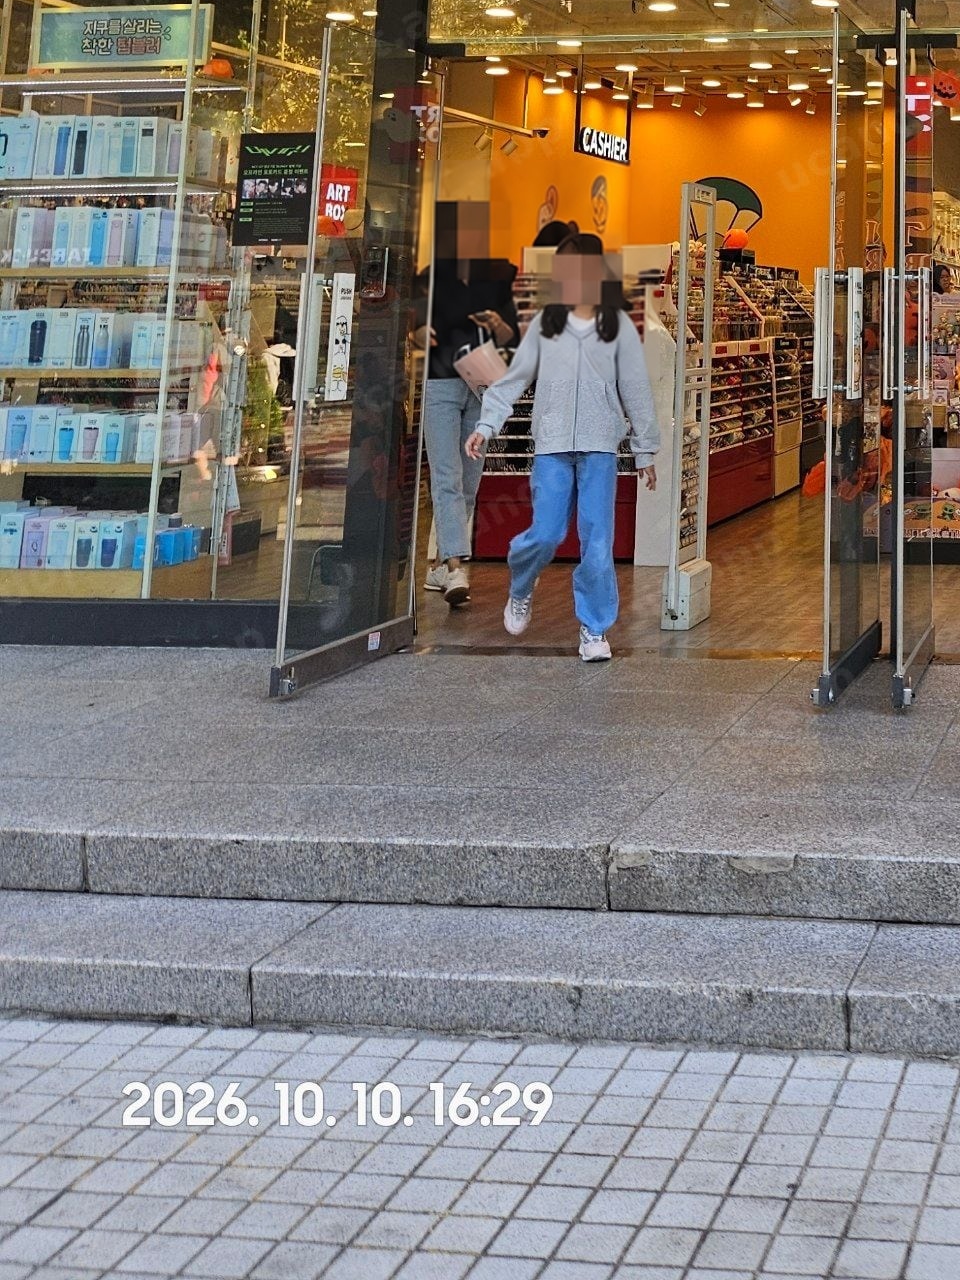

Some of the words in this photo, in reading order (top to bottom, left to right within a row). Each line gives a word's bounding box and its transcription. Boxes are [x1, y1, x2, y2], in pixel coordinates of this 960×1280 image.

[83, 19, 122, 35] 지구를
[123, 19, 163, 35] 살리는
[82, 38, 113, 55] 착한
[117, 37, 162, 55] 텀블러
[583, 126, 628, 162] CASHIER
[326, 183, 350, 202] ART
